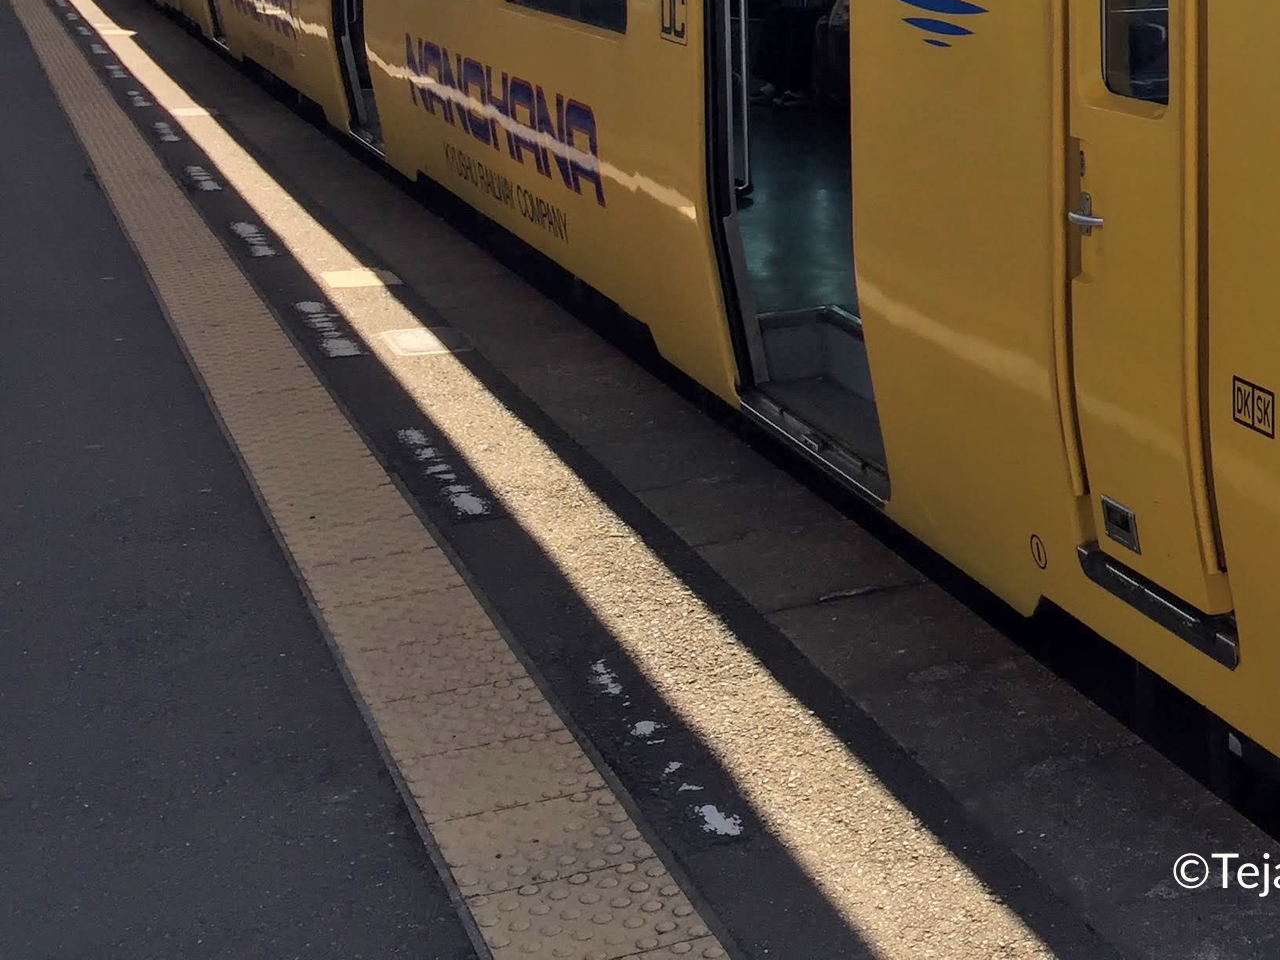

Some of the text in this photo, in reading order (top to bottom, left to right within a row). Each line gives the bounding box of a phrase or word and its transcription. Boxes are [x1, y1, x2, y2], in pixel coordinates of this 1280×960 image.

[516, 184, 570, 245] COMPANY
[1236, 386, 1251, 419] DK
[1256, 395, 1271, 428] SK
